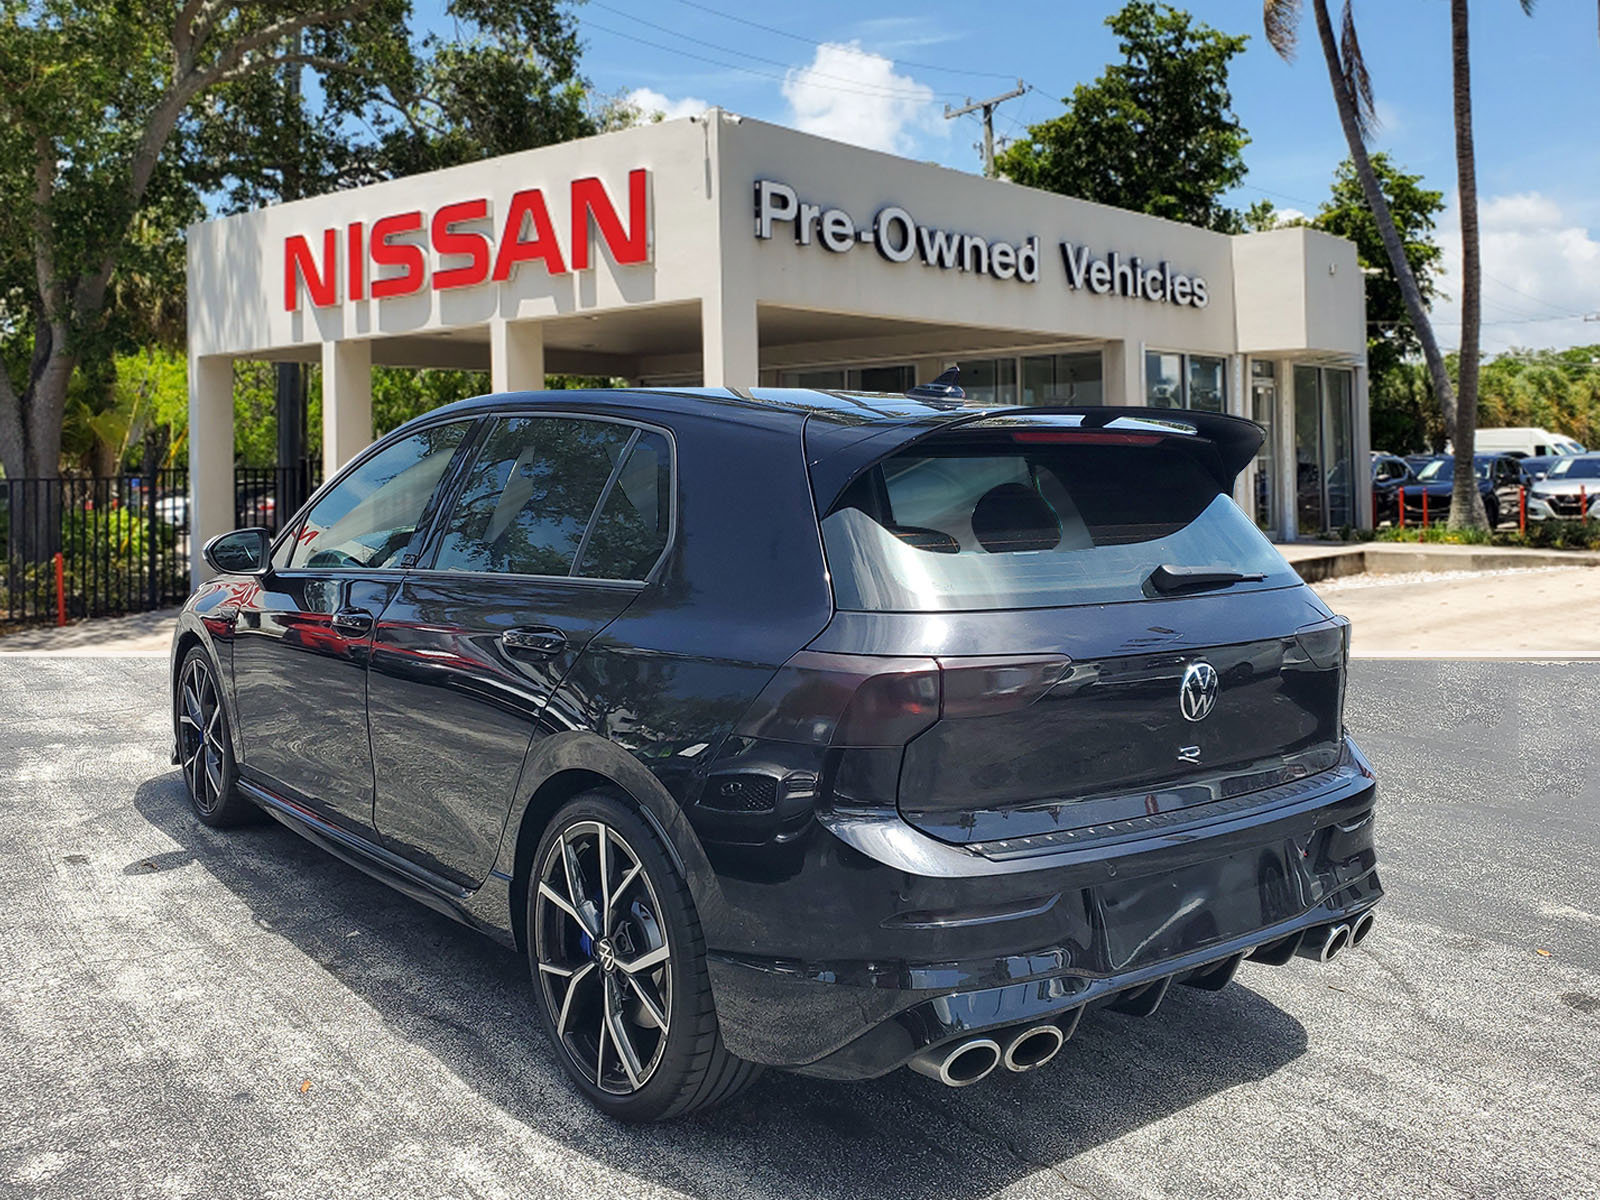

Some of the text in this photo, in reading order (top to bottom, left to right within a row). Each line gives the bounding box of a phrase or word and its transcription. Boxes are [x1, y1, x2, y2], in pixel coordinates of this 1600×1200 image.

[284, 168, 649, 312] NISSAN
[754, 179, 1209, 308] Pre-Owned Vehicles
